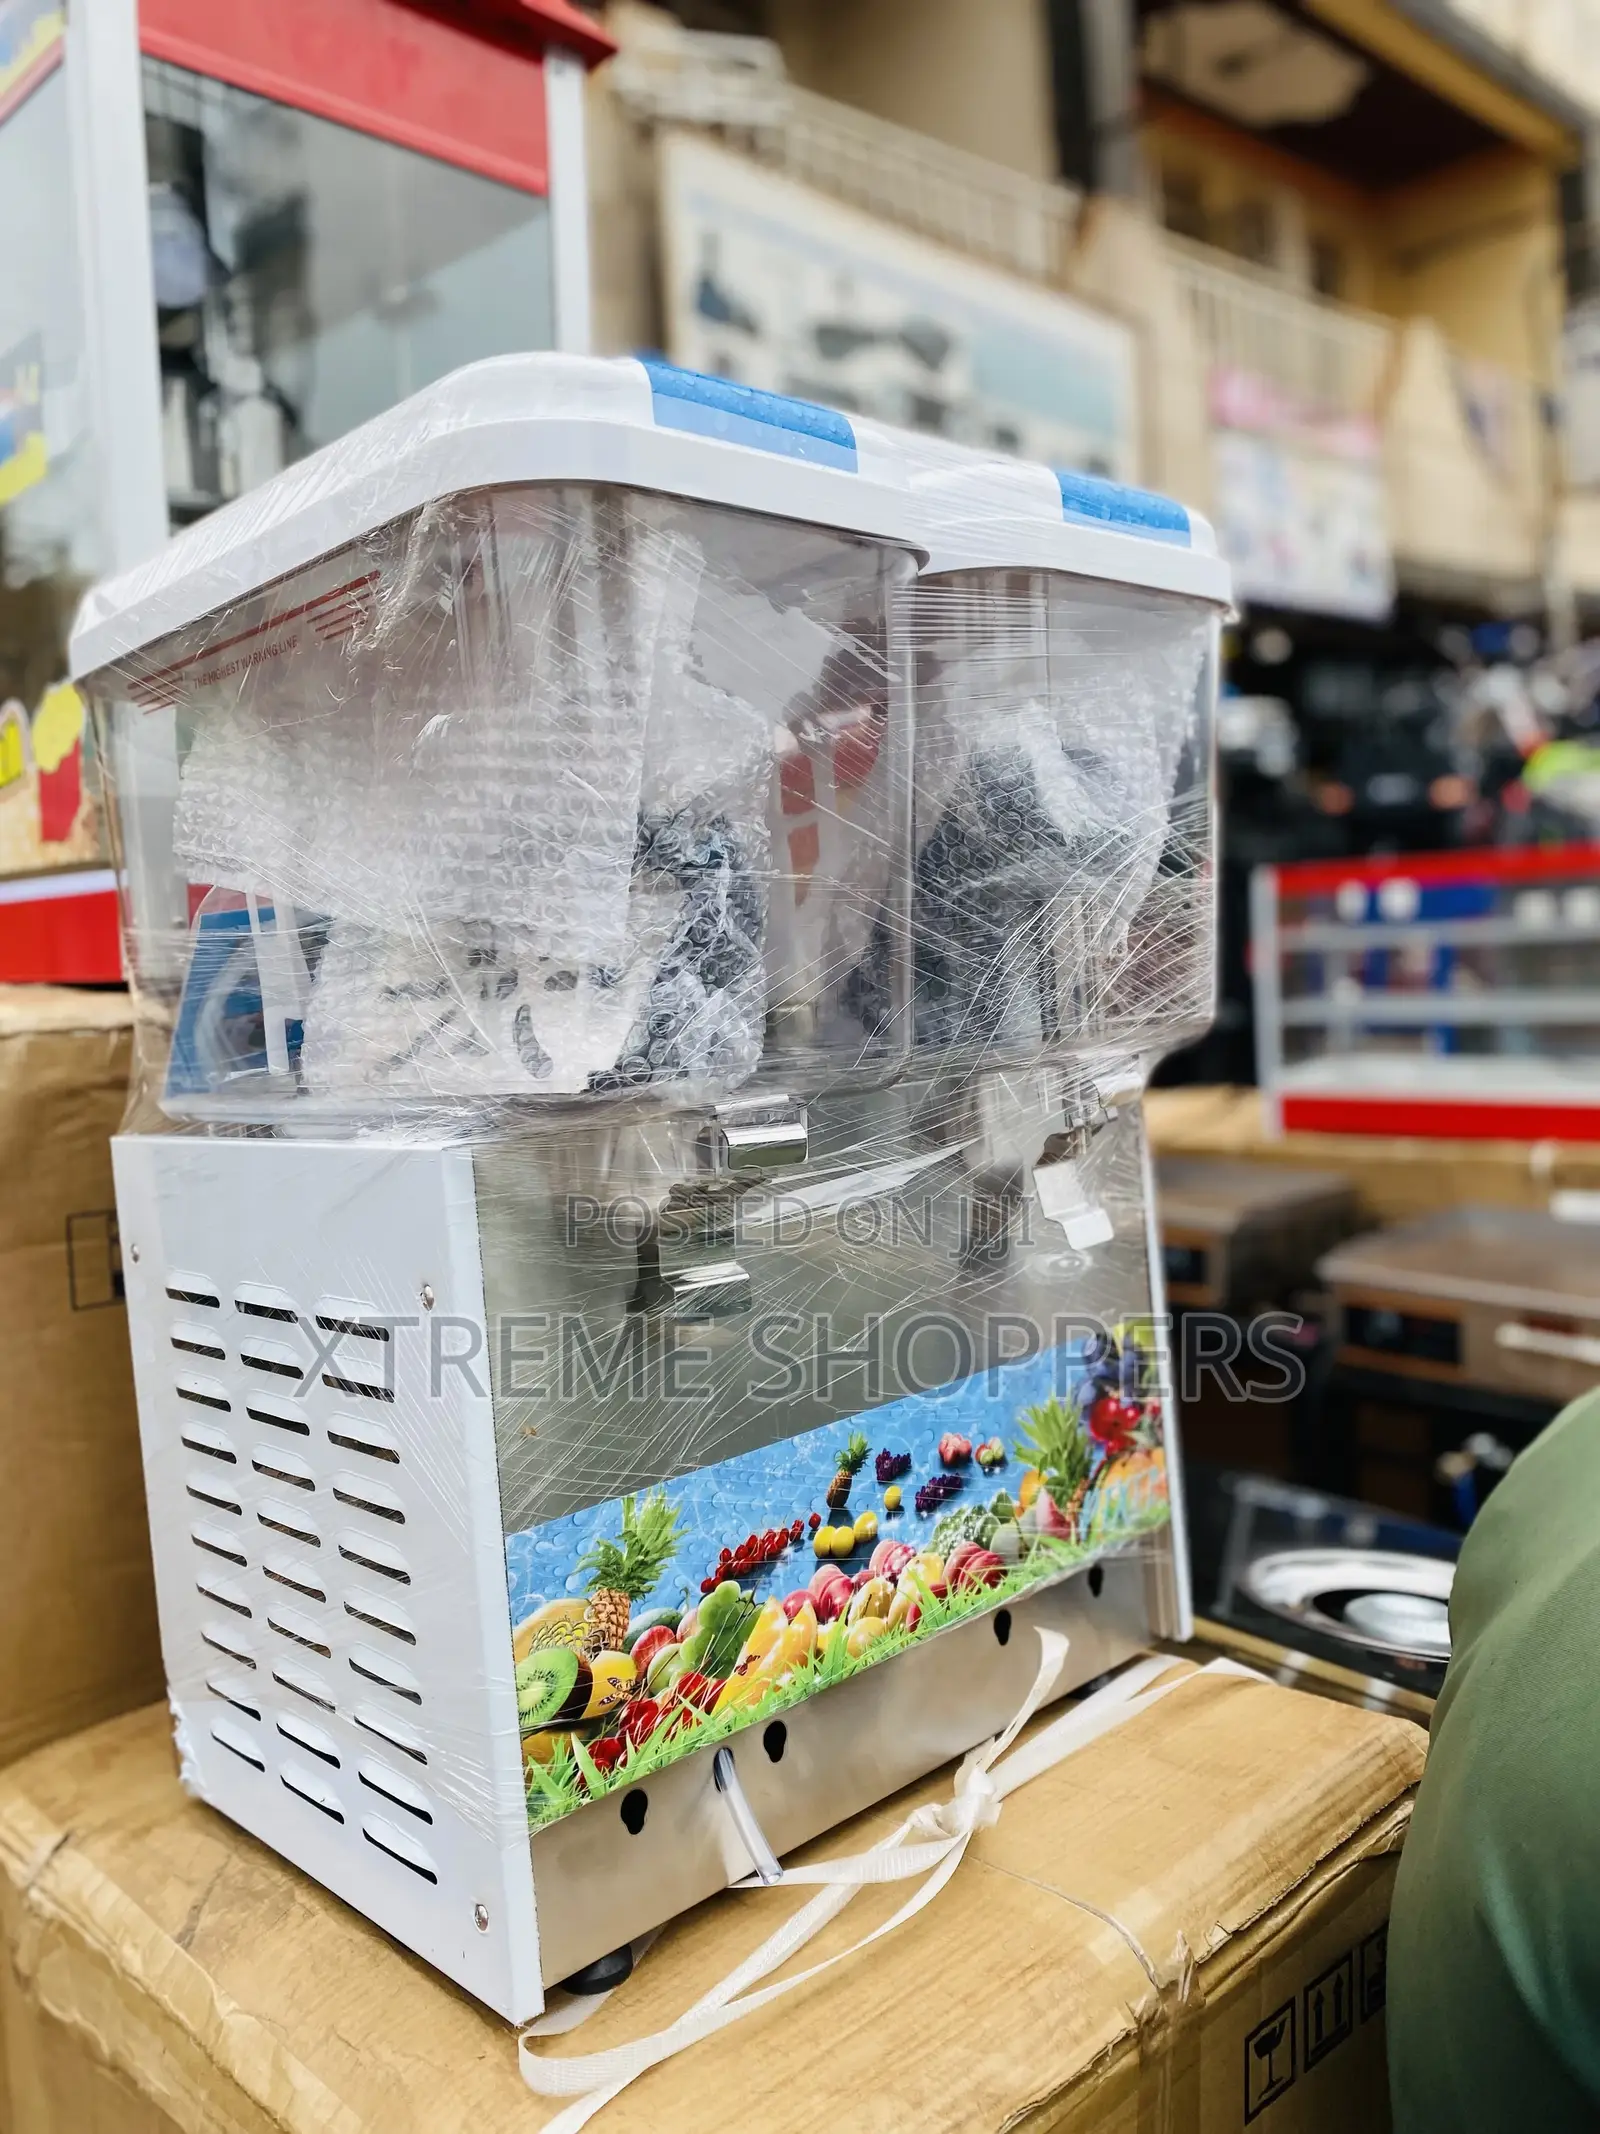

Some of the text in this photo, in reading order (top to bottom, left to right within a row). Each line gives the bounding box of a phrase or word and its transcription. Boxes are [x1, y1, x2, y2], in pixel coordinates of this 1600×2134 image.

[193, 634, 298, 689] THE HIGHEST WARNING LINE
